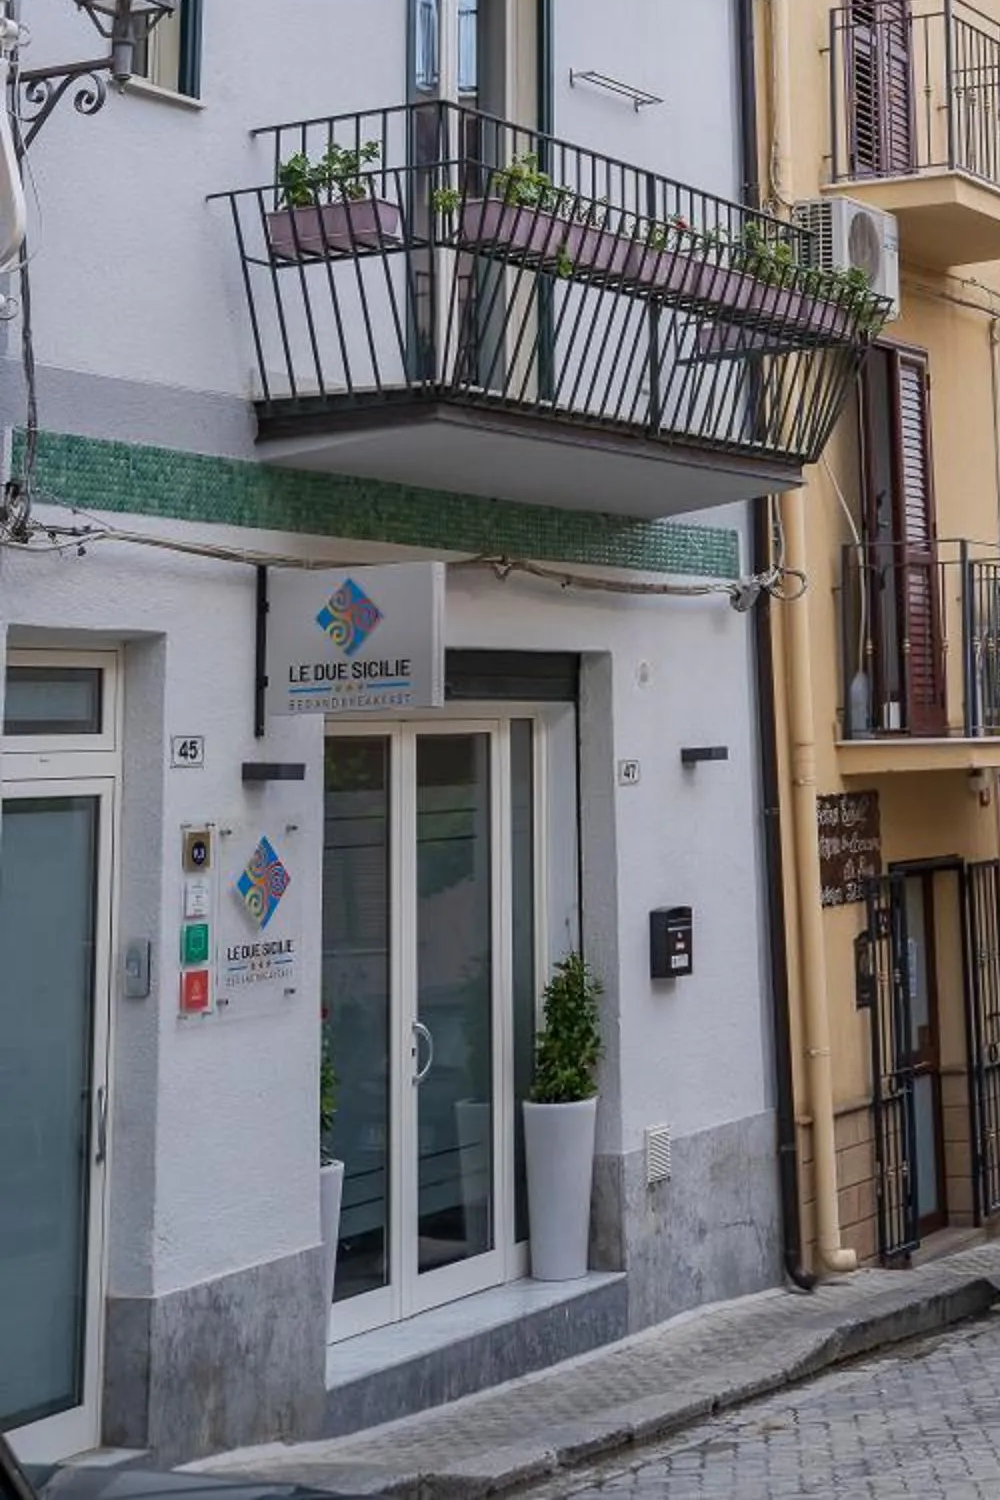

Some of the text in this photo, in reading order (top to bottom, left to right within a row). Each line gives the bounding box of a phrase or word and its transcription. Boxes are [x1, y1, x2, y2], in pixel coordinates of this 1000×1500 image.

[289, 659, 411, 682] LE DUE SICILIE
[179, 740, 198, 760] 45
[623, 763, 637, 779] 47
[227, 946, 240, 961] LE
[241, 943, 261, 959] DUE
